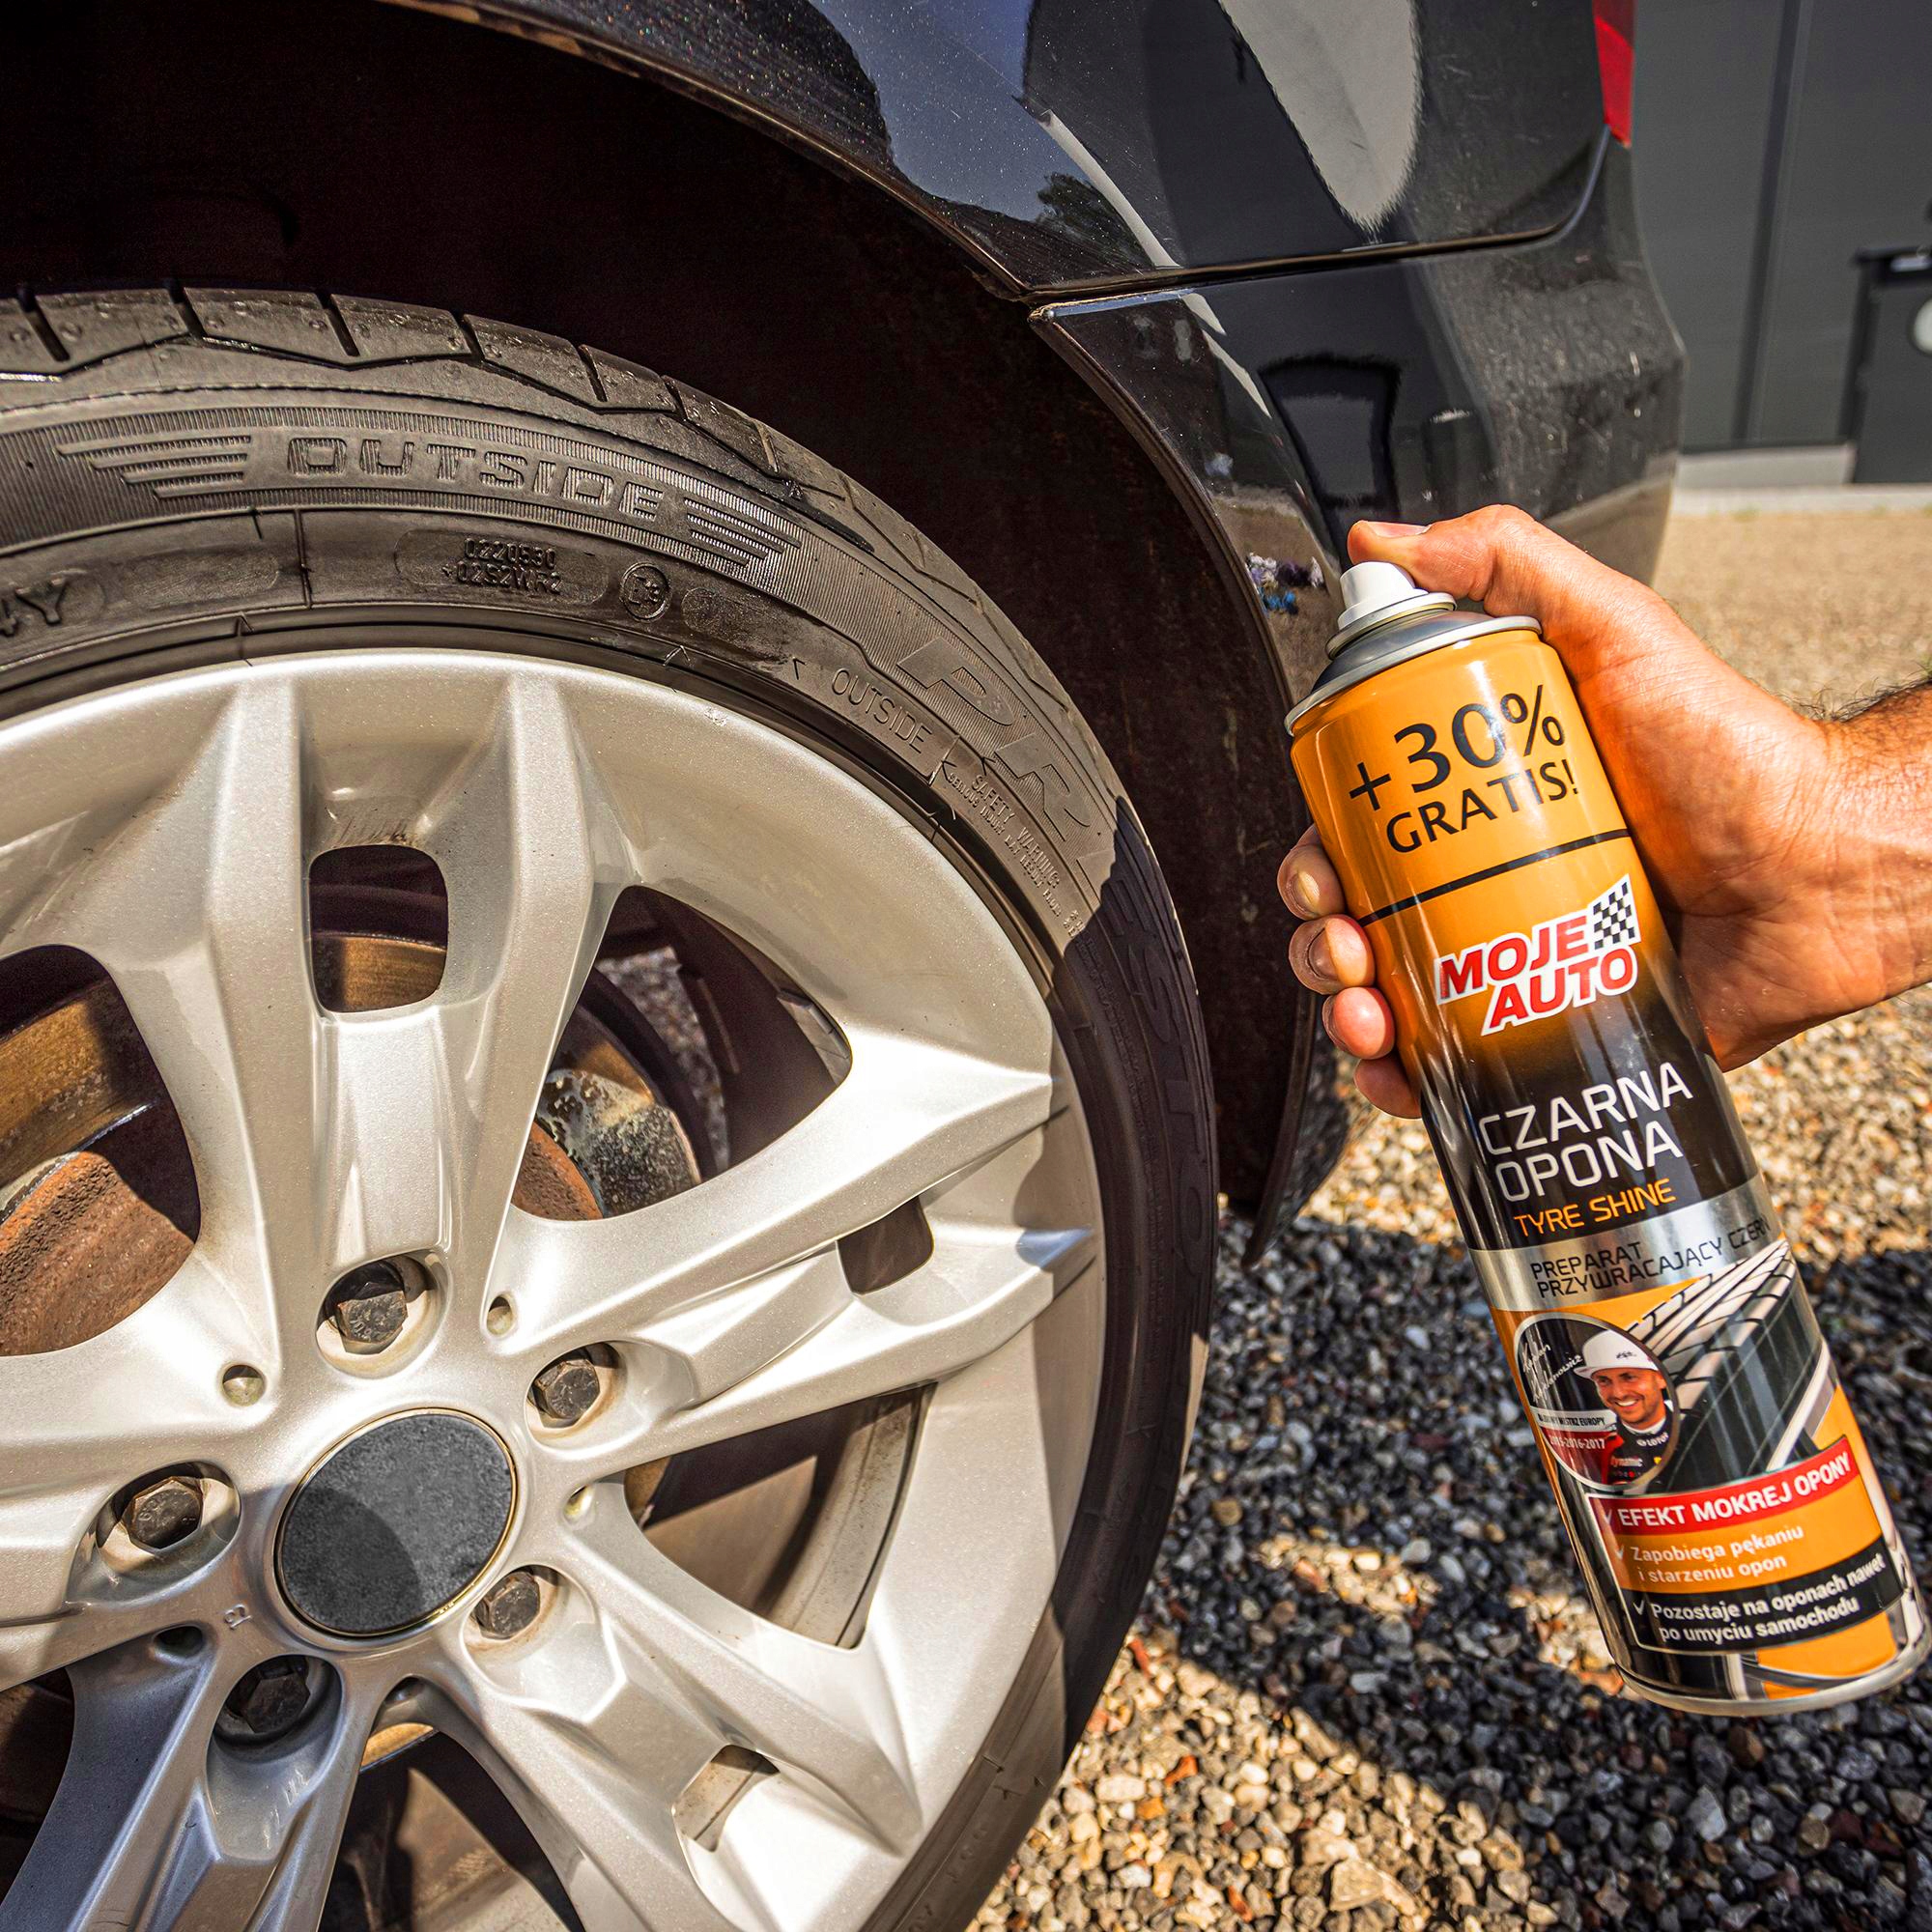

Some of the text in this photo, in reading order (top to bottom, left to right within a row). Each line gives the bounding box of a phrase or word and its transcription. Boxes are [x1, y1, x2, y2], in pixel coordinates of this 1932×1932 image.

[287, 436, 665, 522] OUTSIDE
[831, 668, 933, 755] OUTSIDE
[1385, 759, 1578, 854] GRATIS!
[1439, 915, 1589, 1000] MOJE
[1488, 954, 1634, 1031] AUTO
[1479, 1062, 1693, 1156] CZARNA
[1494, 1121, 1684, 1202] OPONA
[1514, 1178, 1677, 1237] TYRE SHINE
[1530, 1241, 1642, 1280] PREPARAT
[1537, 1237, 1722, 1298] PRZYWRACAJĄCY
[1579, 1417, 1605, 1427] EUROPY
[1619, 1451, 1852, 1527] EFEKT MOKREJ OPONY
[1630, 1524, 1804, 1570] Zapobiega pękaniu
[1638, 1554, 1787, 1584] i starzeniu opon
[1651, 1551, 1887, 1623] Pozostaje na oponach nawet
[1659, 1595, 1861, 1645] po umyciu samochodu
